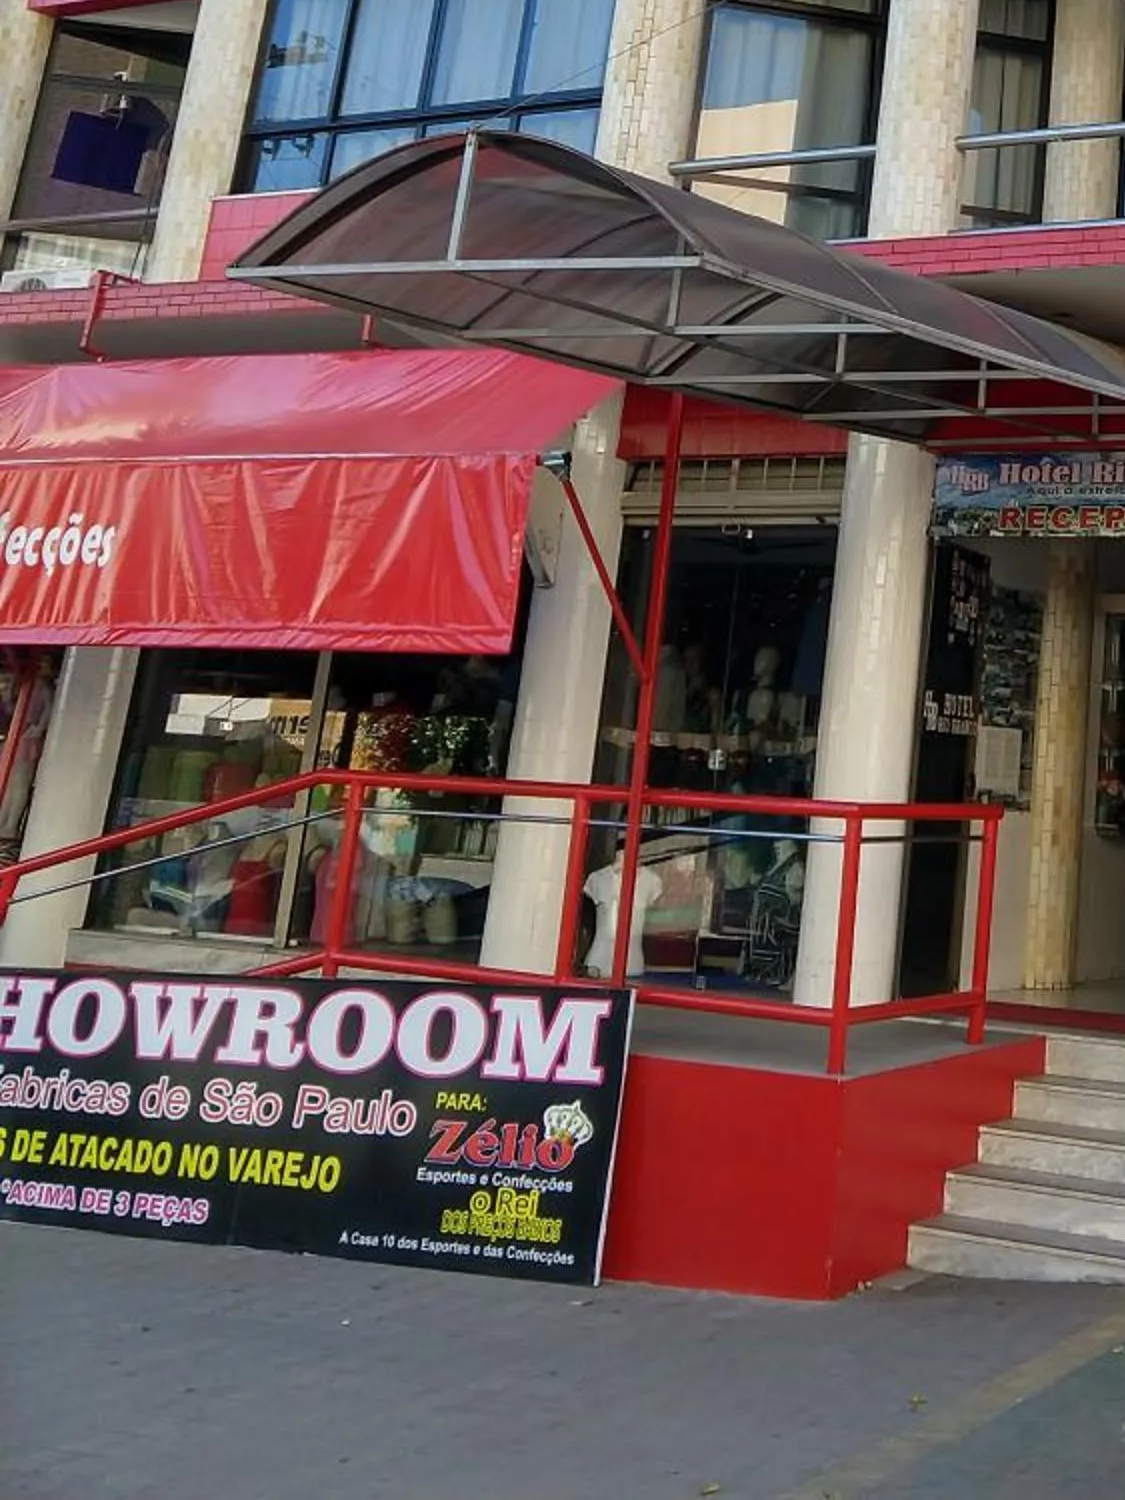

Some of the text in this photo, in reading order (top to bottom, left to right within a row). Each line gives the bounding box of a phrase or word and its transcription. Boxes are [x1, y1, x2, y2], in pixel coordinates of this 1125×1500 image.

[1000, 461, 1082, 486] Hotel
[0, 1065, 417, 1137] abricas de São Paulo
[435, 1091, 488, 1112] PARA:
[10, 1128, 49, 1164] DE
[48, 1131, 173, 1178] ATACADO
[177, 1143, 221, 1180] NO
[227, 1146, 342, 1194] VAREJO
[423, 1117, 577, 1173] Zélio
[416, 1167, 574, 1194] Esportes e Confecções
[79, 1187, 114, 1214] DE
[113, 1191, 130, 1216] 3
[131, 1194, 210, 1227] PEÇAS
[468, 1186, 541, 1220] o Rei
[338, 1230, 349, 1244] A
[351, 1231, 379, 1248] Casa
[397, 1235, 419, 1251] dos
[420, 1238, 470, 1257] Esportes
[473, 1245, 482, 1256] e
[483, 1243, 503, 1258] das
[506, 1245, 576, 1266] Confecções
